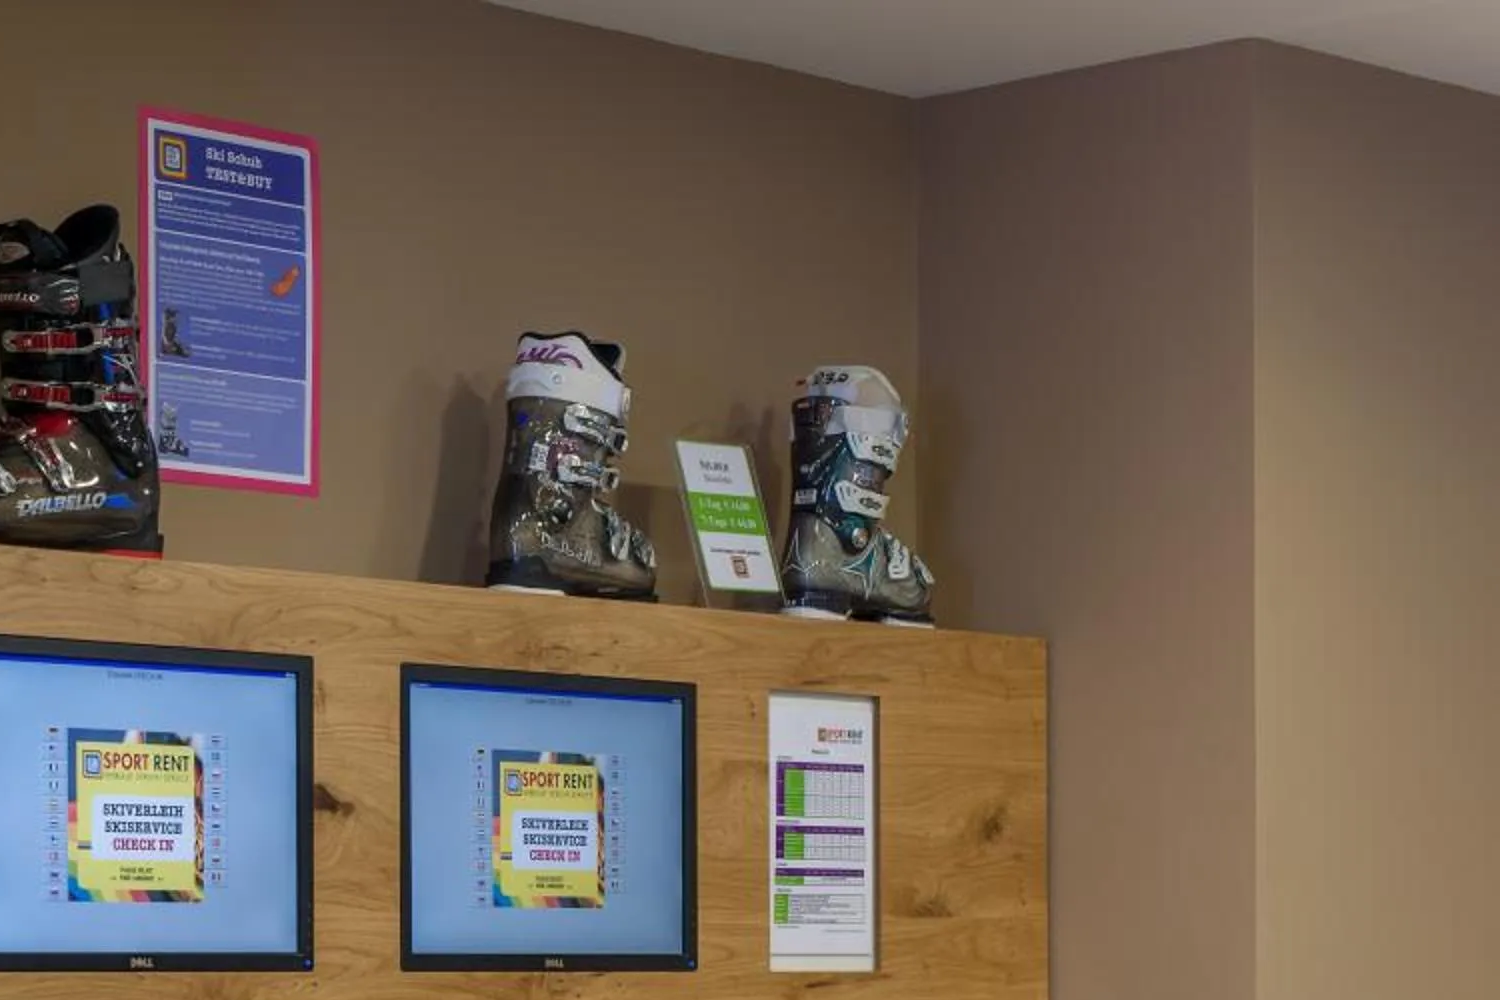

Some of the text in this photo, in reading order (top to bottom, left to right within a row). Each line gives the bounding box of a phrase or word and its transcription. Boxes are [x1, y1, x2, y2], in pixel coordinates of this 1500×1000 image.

[15, 491, 107, 517] DALBELLO
[103, 751, 191, 773] SPORT RENT
[523, 771, 594, 790] SPORT RENT
[103, 803, 184, 818] SKIVERLEIH
[104, 820, 183, 835] SKISERVICE
[113, 837, 175, 851] CHECK IN
